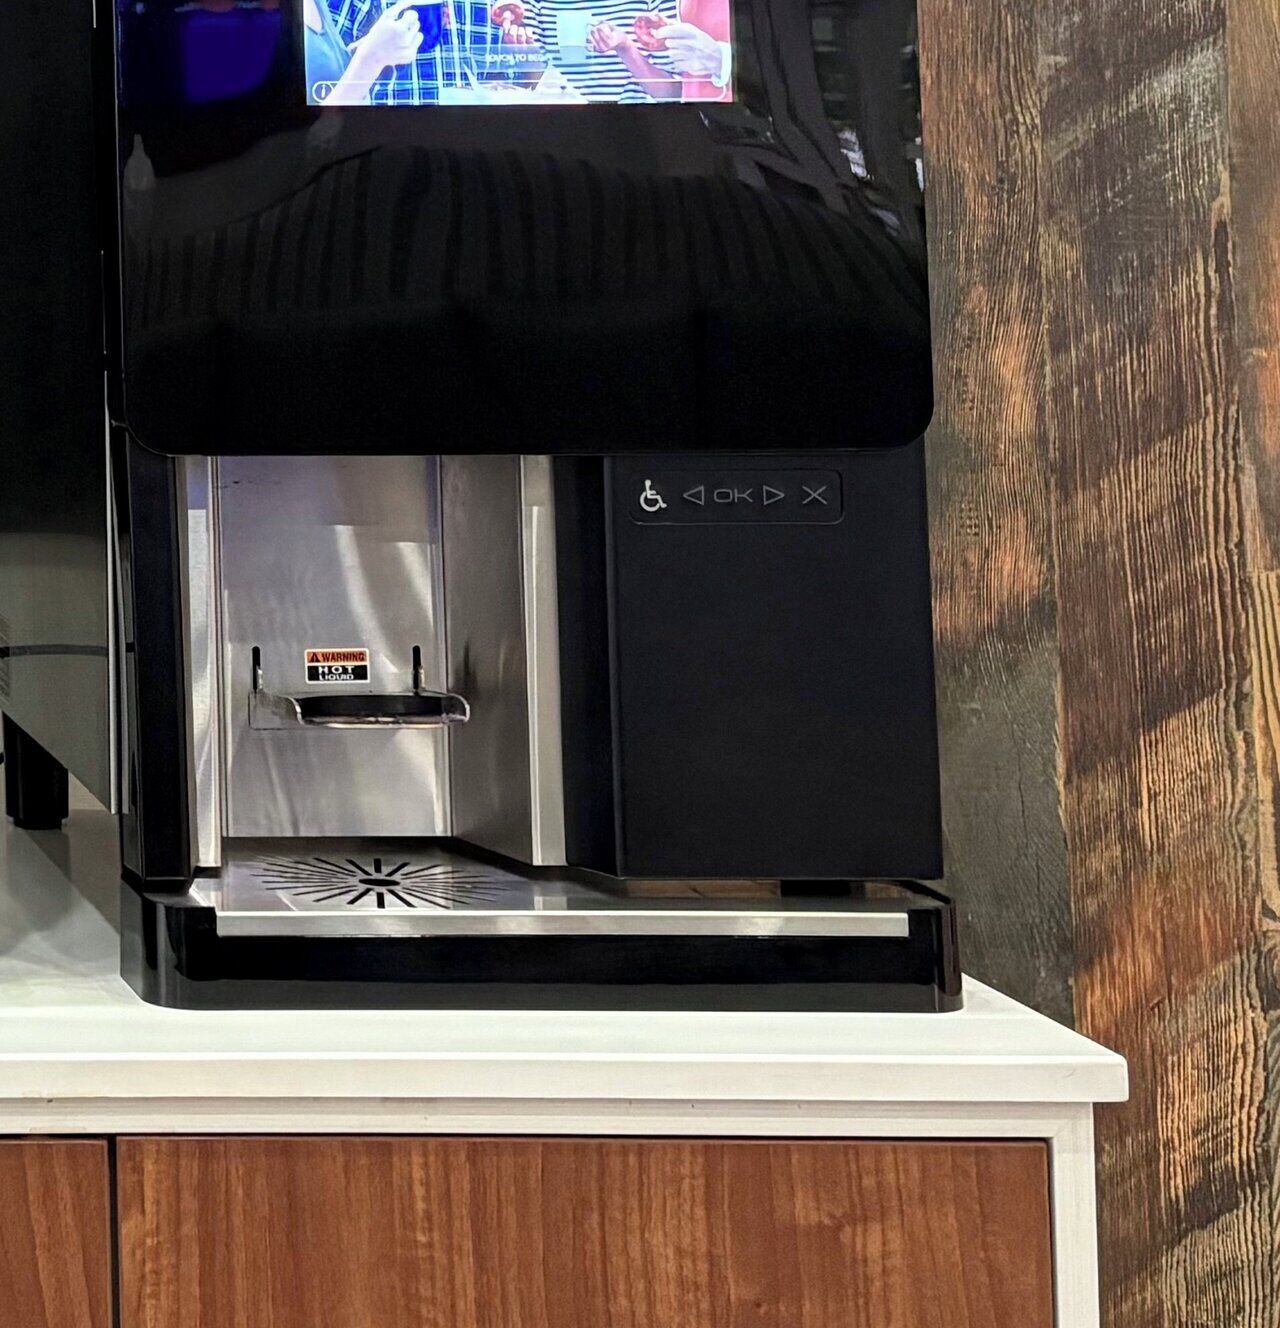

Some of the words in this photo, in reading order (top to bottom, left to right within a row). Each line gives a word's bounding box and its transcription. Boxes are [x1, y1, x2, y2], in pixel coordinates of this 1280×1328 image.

[713, 487, 754, 504] OK
[321, 652, 365, 663] WARNING
[318, 665, 355, 674] HOT
[318, 673, 355, 681] LIQUID
